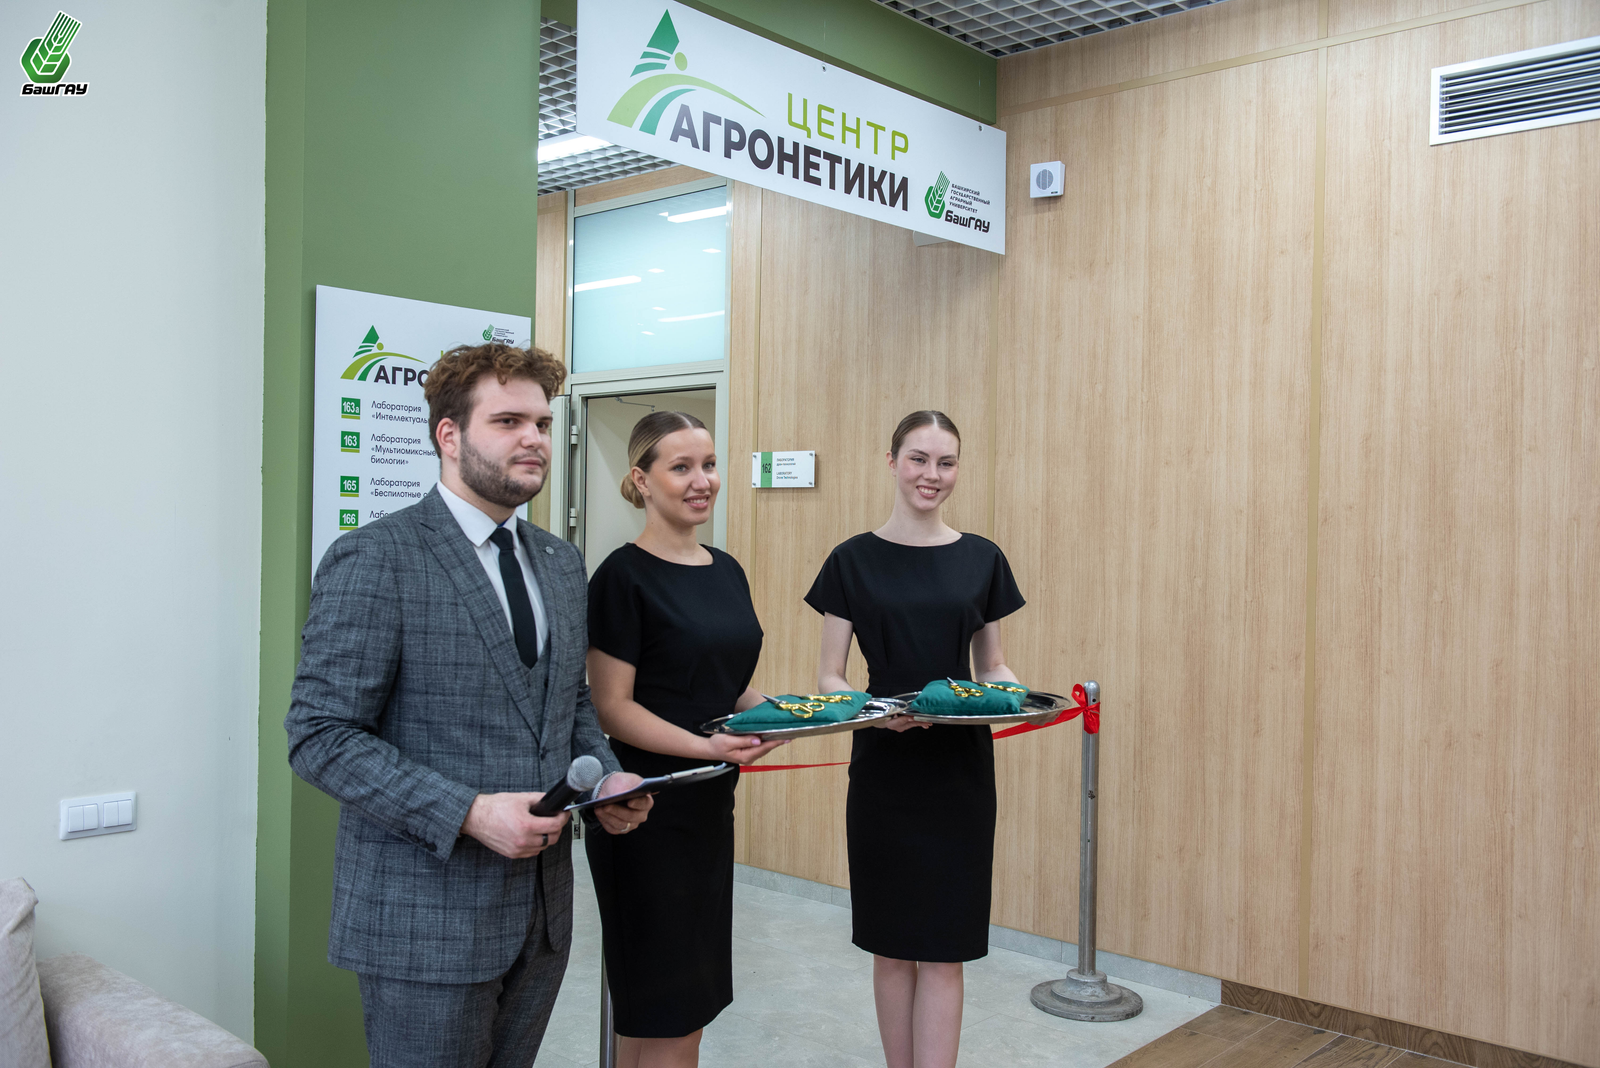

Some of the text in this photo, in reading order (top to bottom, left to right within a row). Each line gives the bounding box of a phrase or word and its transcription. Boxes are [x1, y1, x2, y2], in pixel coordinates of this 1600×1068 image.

[788, 92, 909, 161] ЦЕНТР
[669, 103, 909, 212] АГРОНЕТИКИ
[951, 183, 980, 196] БАШКИРСКИЙ
[949, 195, 973, 206] АГРАРНЫЙ
[950, 189, 990, 205] ГОСУДАРСТВЕННЫЙ
[949, 202, 978, 214] УНИВЕРСИТЕТ
[944, 209, 991, 233] БашГАУ
[371, 400, 422, 413] Лаборатория
[343, 435, 358, 446] 163
[370, 433, 421, 446] Лаборатория
[370, 455, 409, 465] биологии»
[762, 463, 772, 474] 162
[342, 480, 357, 491] 165
[370, 477, 421, 489] Лаборатория
[370, 489, 422, 499] «Беспилотные
[342, 513, 356, 525] 166
